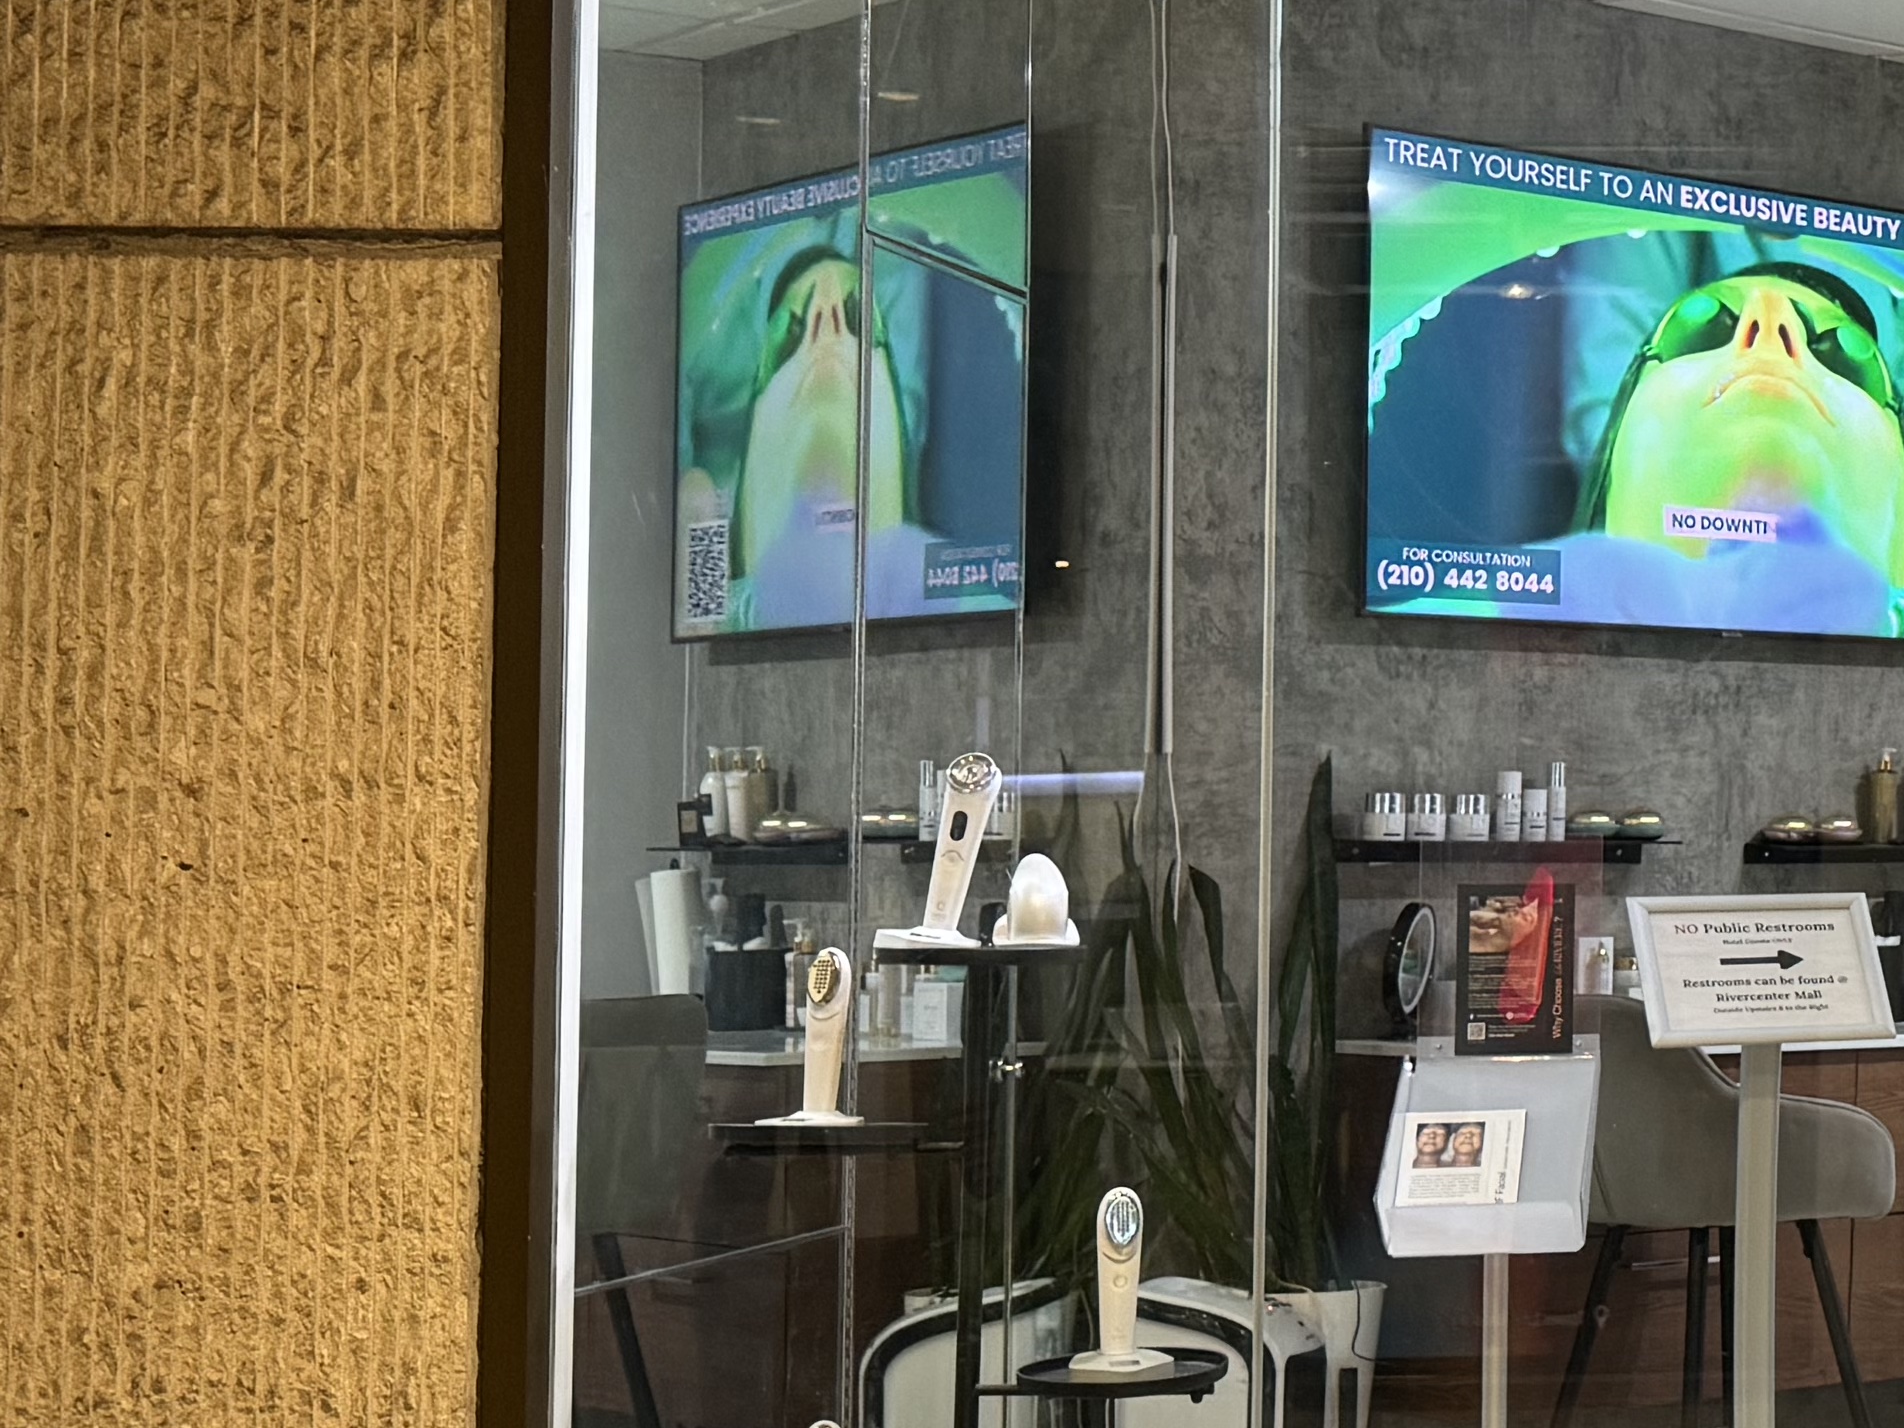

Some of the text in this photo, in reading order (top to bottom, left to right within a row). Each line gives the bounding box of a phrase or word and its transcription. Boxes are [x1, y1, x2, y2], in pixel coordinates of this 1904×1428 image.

[1384, 137, 1463, 172] TREAT
[1469, 151, 1592, 192] YOURSELF
[1599, 171, 1633, 199] TO
[1640, 179, 1673, 205] AN
[1680, 185, 1808, 227] EXCLUSIVE
[1813, 206, 1901, 241] BEAUTY
[1672, 513, 1696, 528] NO
[1402, 547, 1531, 567] FOR CONSULTATION
[1377, 559, 1555, 594] (210) 442 8044
[1674, 921, 1835, 935] NO Public Restrooms
[1682, 978, 1752, 989] Restrooms
[1754, 978, 1777, 986] can
[1780, 975, 1796, 985] be
[1798, 974, 1835, 985] found
[1551, 977, 1563, 1015] Choose
[1715, 989, 1823, 1003] Rivercenter Mall
[1551, 1016, 1564, 1039] Why
